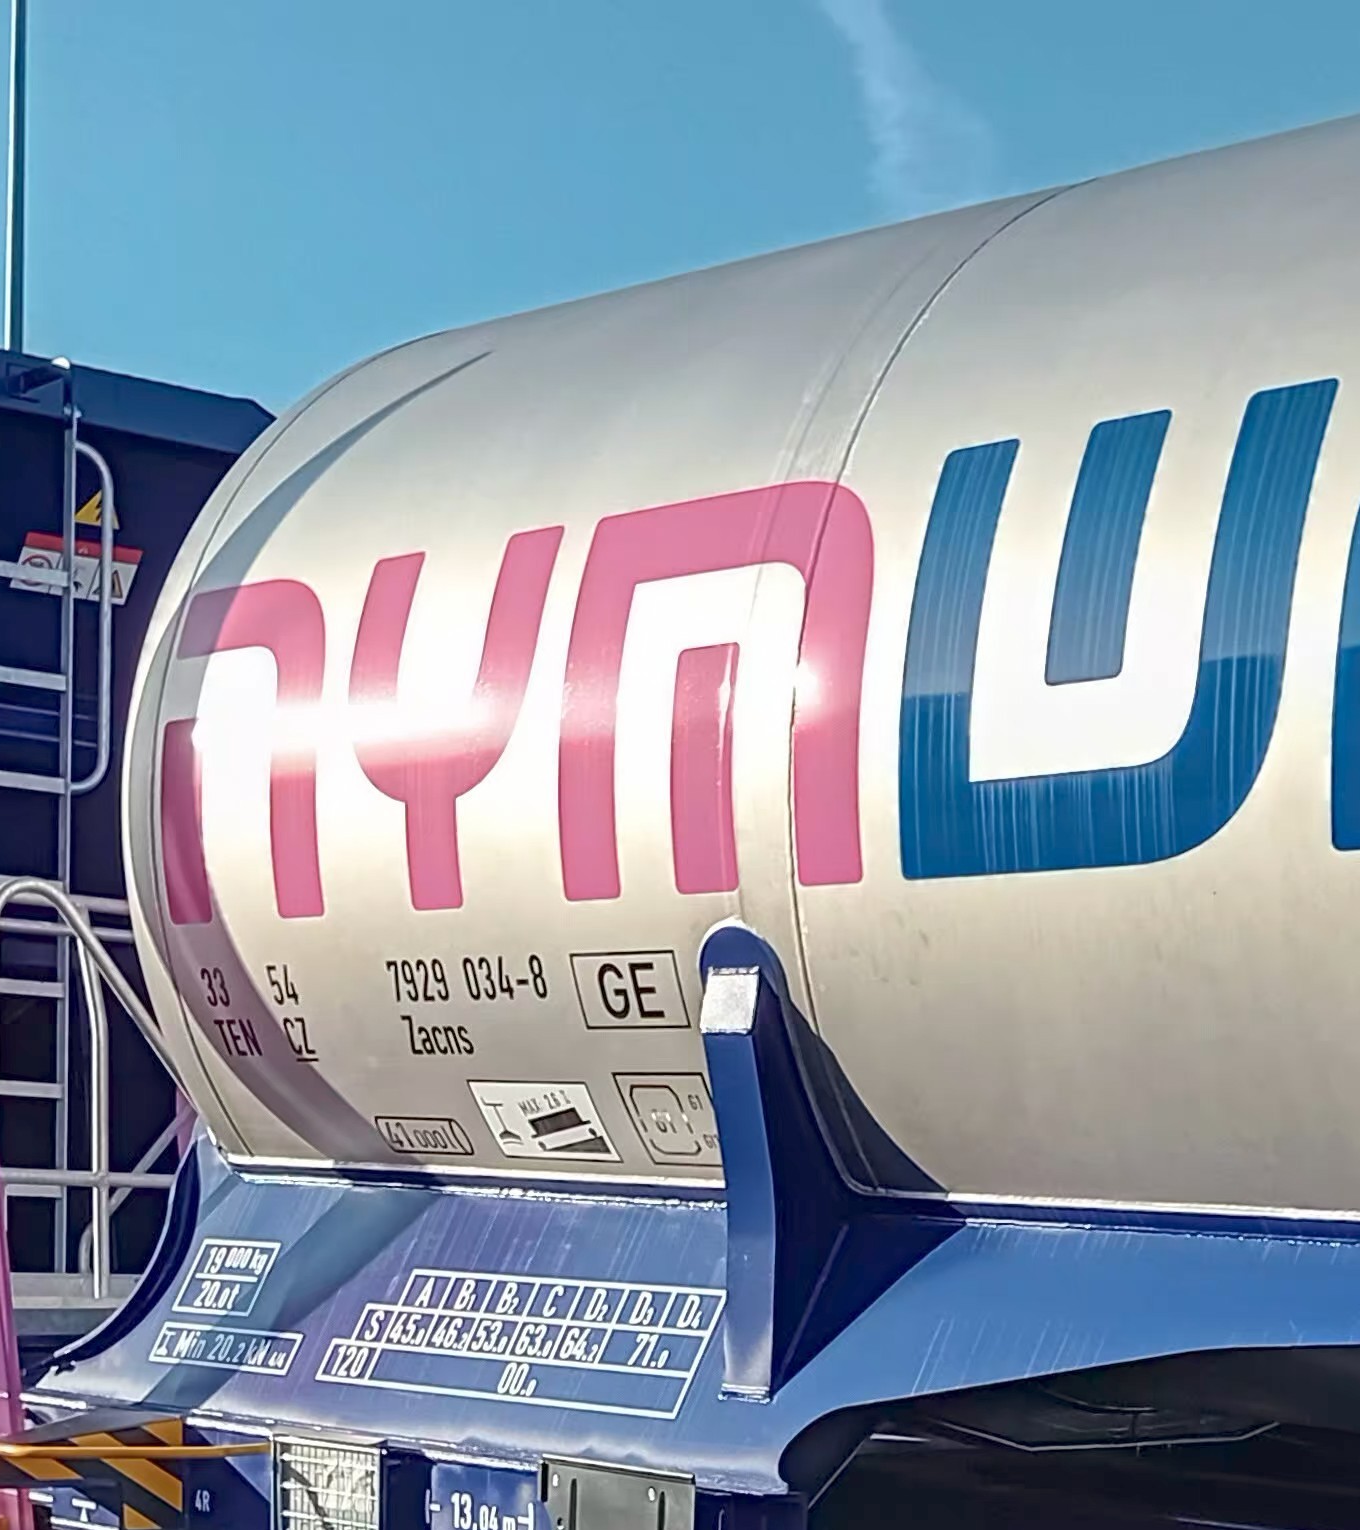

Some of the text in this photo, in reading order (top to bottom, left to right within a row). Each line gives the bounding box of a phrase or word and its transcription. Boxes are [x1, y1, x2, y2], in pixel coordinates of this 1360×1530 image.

[200, 954, 549, 1007] 33 54 7929 034-8
[597, 961, 666, 1020] GE
[214, 1017, 318, 1057] TEN CZ
[401, 1015, 474, 1056] Zacns
[414, 1277, 435, 1308] A
[543, 1285, 564, 1318] C
[363, 1313, 384, 1341] S
[330, 1345, 368, 1378] 120
[195, 1489, 211, 1512] 4R
